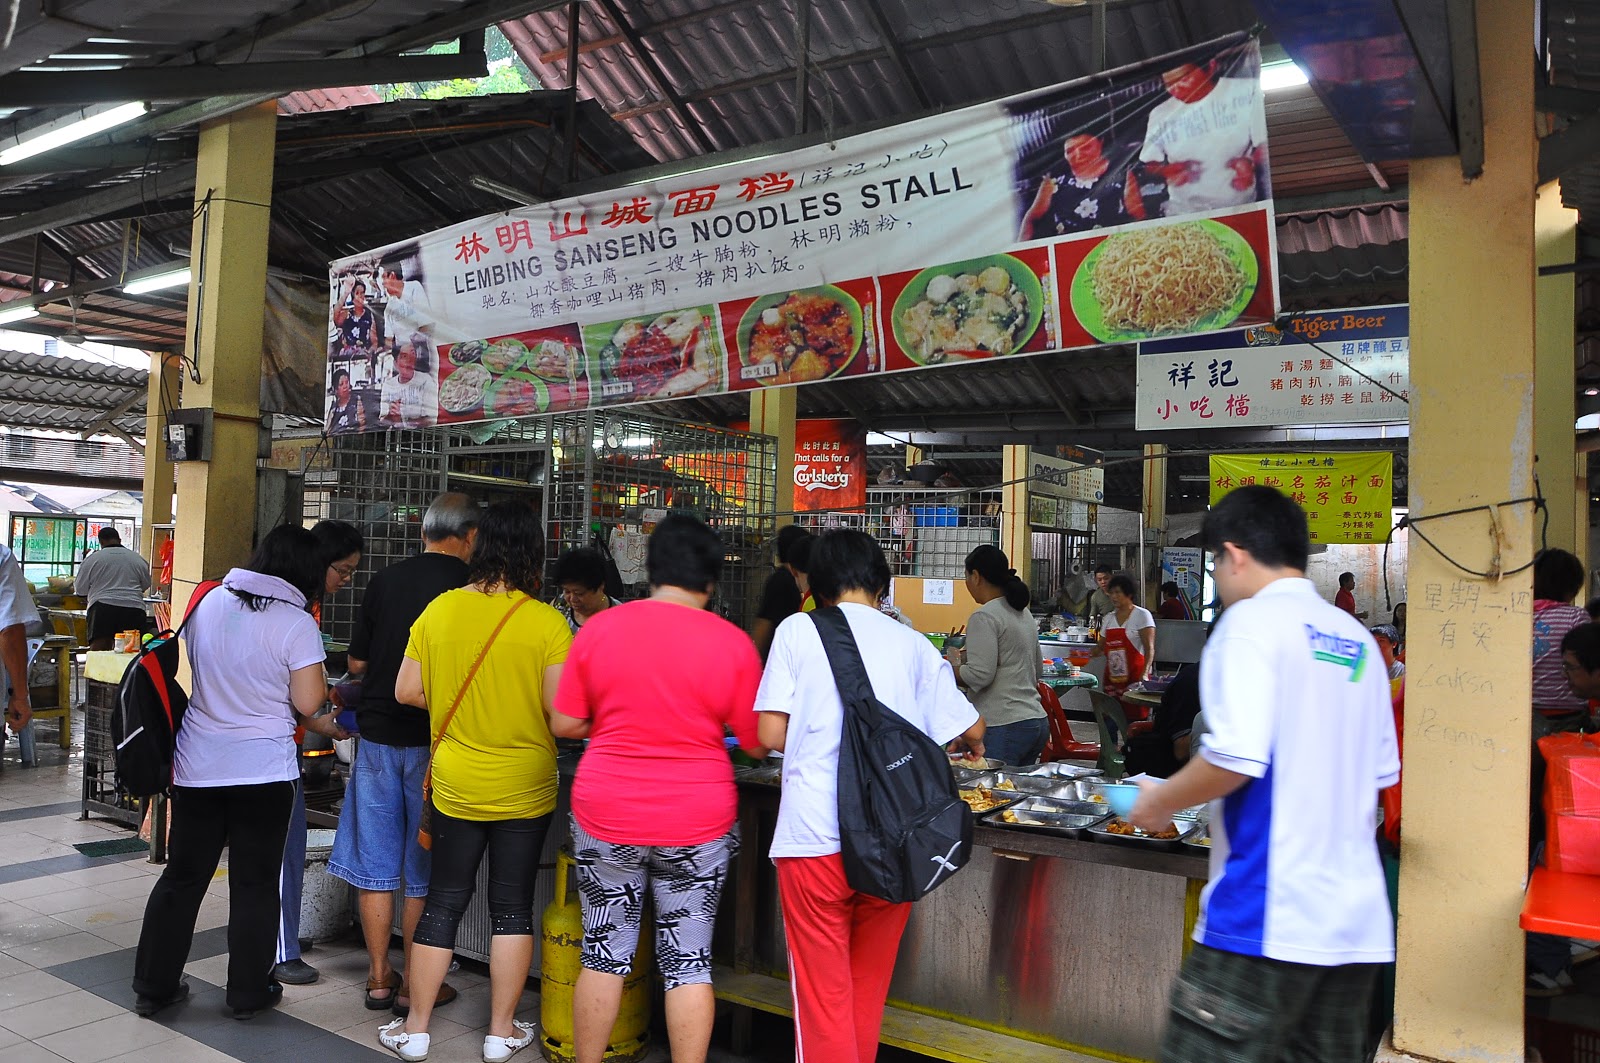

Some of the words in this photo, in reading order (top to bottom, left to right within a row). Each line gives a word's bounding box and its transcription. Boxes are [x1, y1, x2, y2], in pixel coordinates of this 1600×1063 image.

[454, 171, 795, 265] 林明山城面档
[454, 255, 543, 295] LEMBING
[554, 227, 678, 272] SANSENG
[691, 192, 842, 244] NOODLES
[861, 166, 973, 210] STALL
[1292, 316, 1339, 339] Tiger
[1341, 314, 1386, 330] Beer
[1341, 339, 1409, 356] 招牌釀豆
[1167, 358, 1239, 391] 祥記
[1157, 394, 1251, 420] 小吃檔
[812, 454, 830, 462] calls
[831, 454, 842, 462] for
[793, 464, 849, 488] Carlsberg
